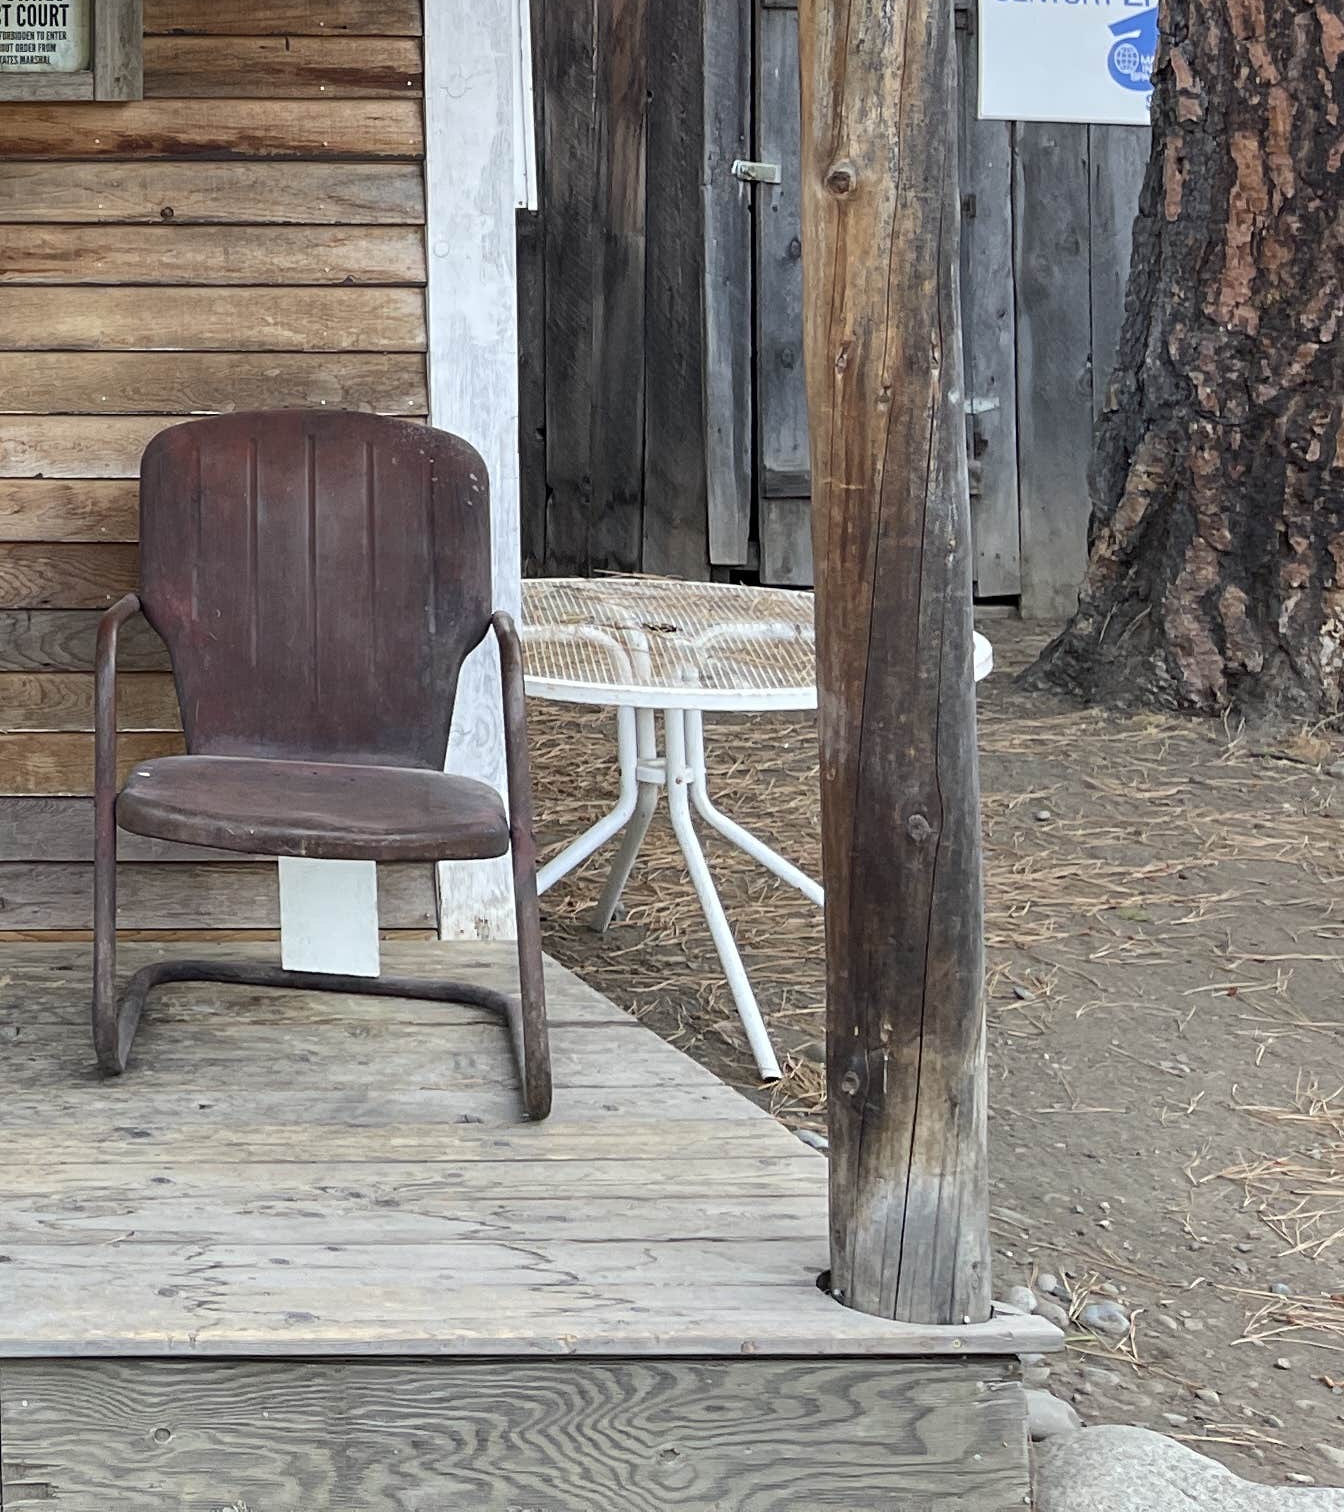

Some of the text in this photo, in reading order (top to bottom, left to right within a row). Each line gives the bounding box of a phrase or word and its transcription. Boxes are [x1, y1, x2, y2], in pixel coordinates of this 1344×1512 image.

[16, 3, 70, 28] COURT
[36, 30, 45, 41] TO
[46, 30, 68, 41] ENTER
[15, 42, 36, 53] ORDER
[38, 42, 57, 53] FROM
